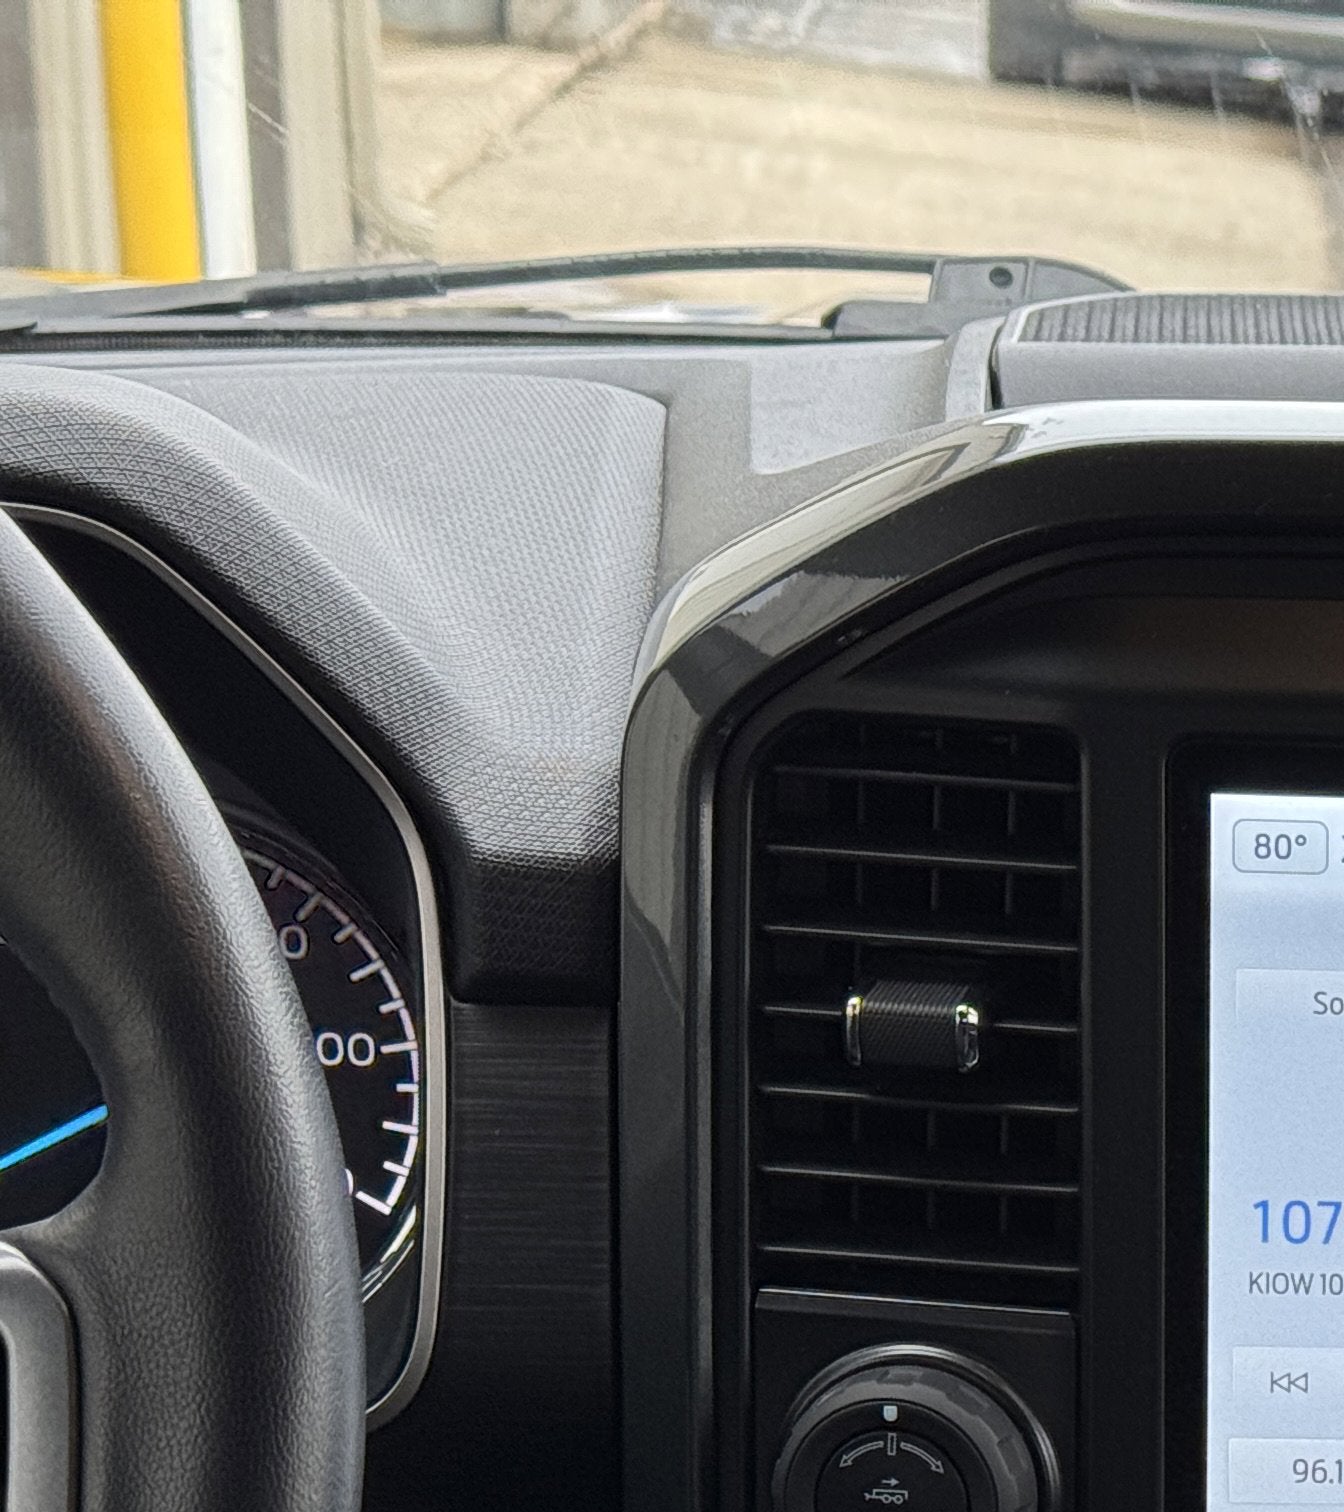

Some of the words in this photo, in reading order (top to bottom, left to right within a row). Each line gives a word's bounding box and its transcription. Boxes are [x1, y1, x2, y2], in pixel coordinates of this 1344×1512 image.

[1253, 833, 1308, 861] 80°
[316, 1032, 375, 1066] 00
[1248, 1272, 1314, 1296] KIOW
[1291, 1459, 1344, 1485] 96.1
